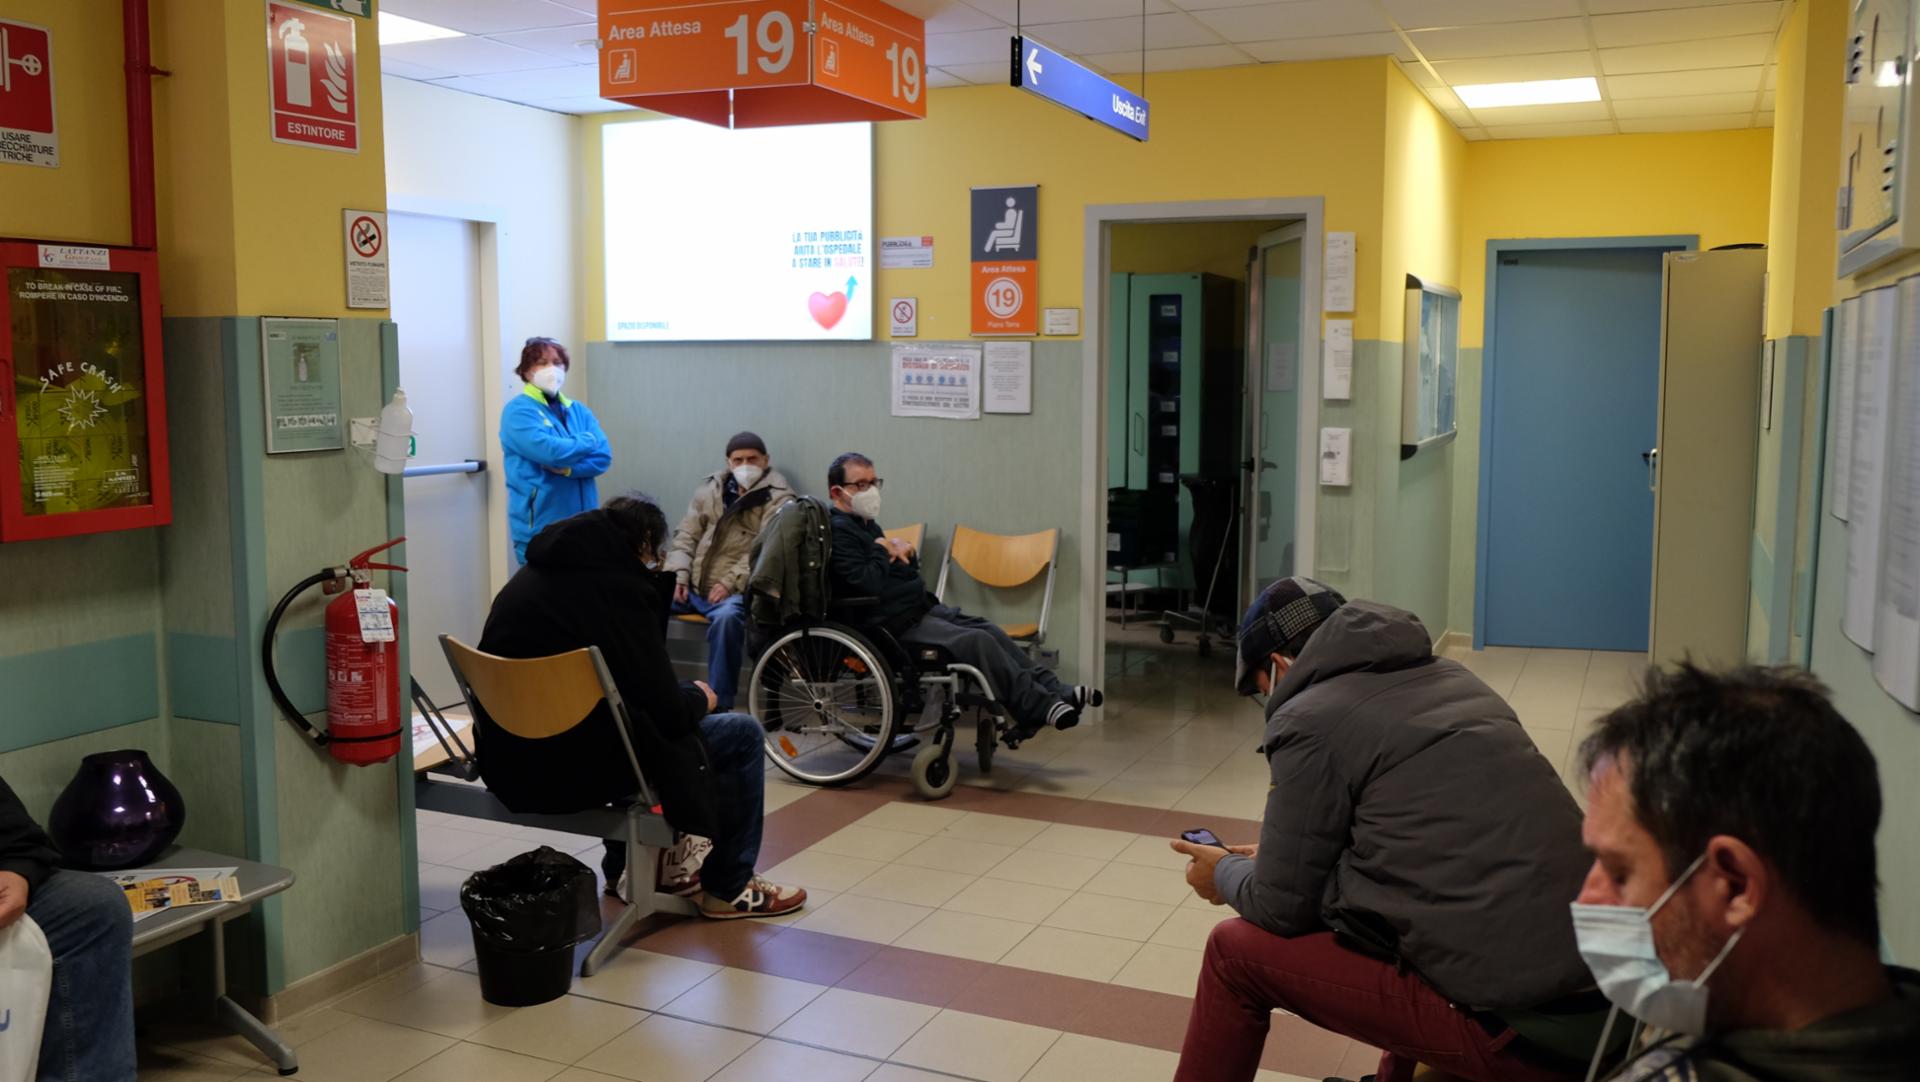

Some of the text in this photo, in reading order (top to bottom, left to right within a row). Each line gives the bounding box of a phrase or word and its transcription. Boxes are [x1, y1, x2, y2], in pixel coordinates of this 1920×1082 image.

[608, 20, 702, 41] Area Attesa
[821, 11, 875, 48] Area Attesa
[724, 10, 795, 75] 19
[885, 41, 920, 104] 19
[1113, 94, 1134, 120] Uscita
[1, 132, 32, 143] USARE
[287, 121, 346, 142] ESTINTORE
[982, 266, 1000, 274] Area
[991, 287, 1016, 309] 19
[40, 361, 122, 395] SAFE CRASH
